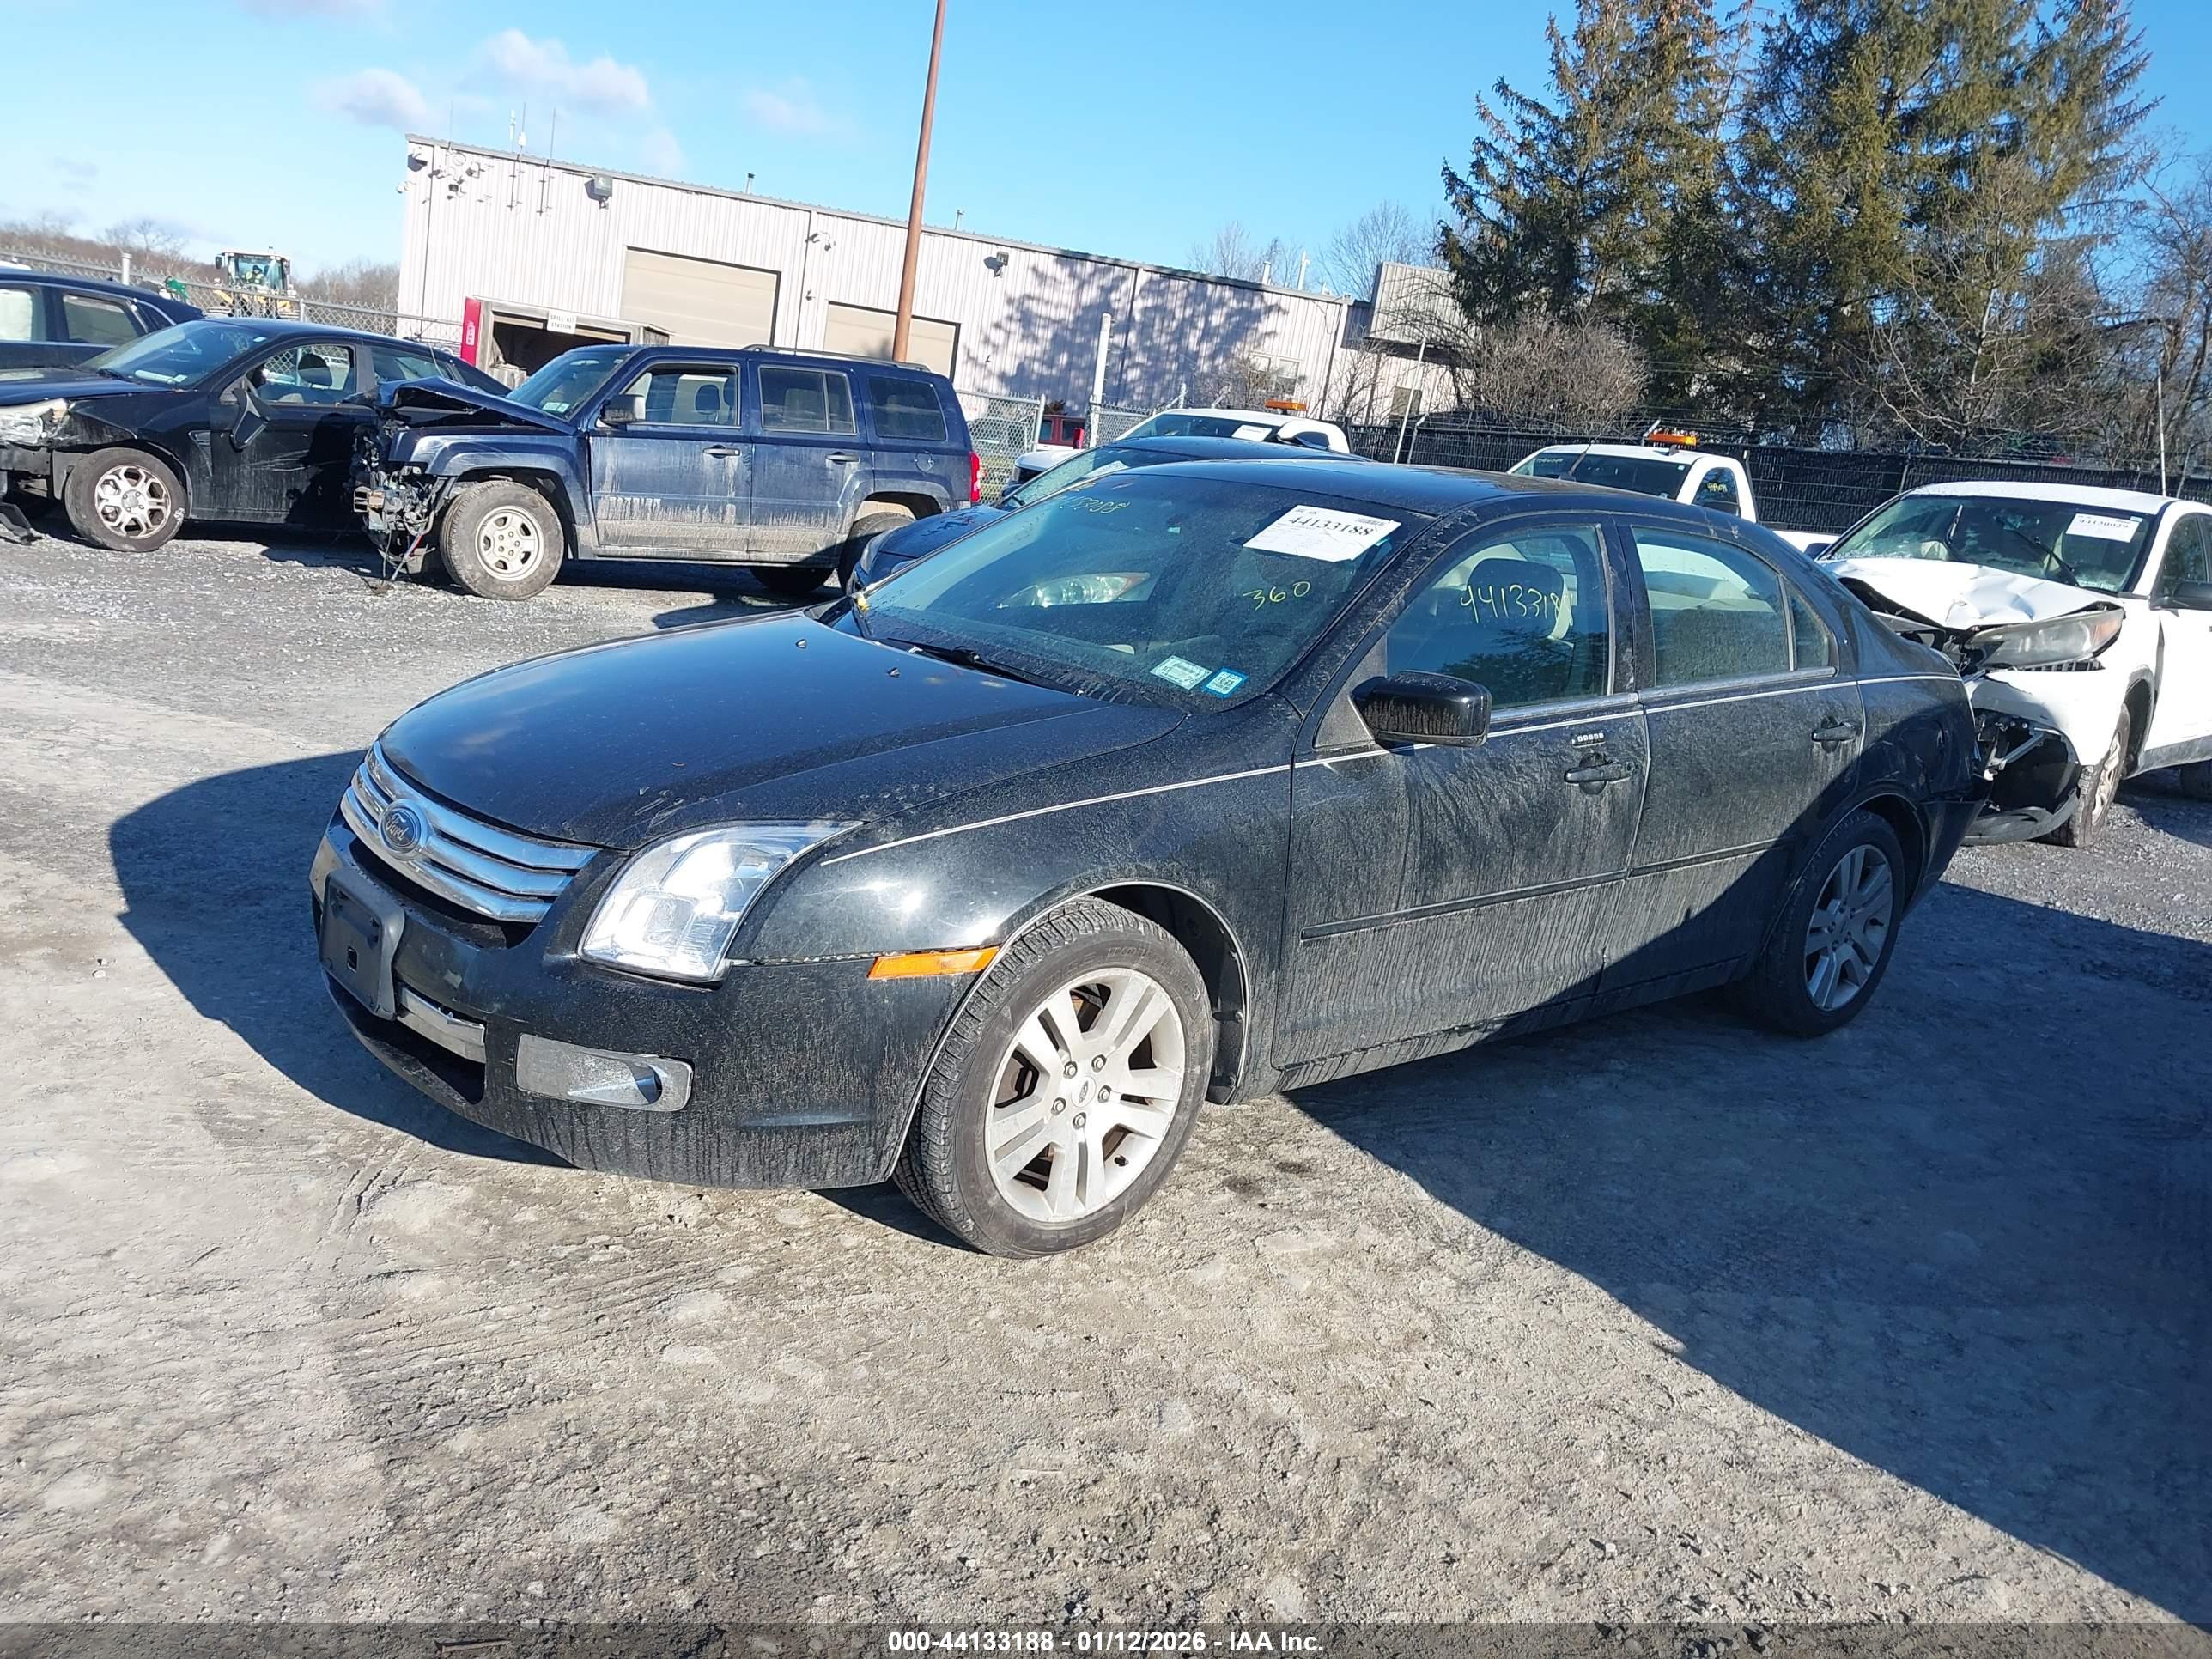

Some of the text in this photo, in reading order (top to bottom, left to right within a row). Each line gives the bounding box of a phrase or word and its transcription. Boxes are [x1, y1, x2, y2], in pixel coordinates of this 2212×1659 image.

[1289, 516, 1375, 537] 44133188
[1243, 580, 1311, 611] 360
[386, 812, 410, 841] Ford
